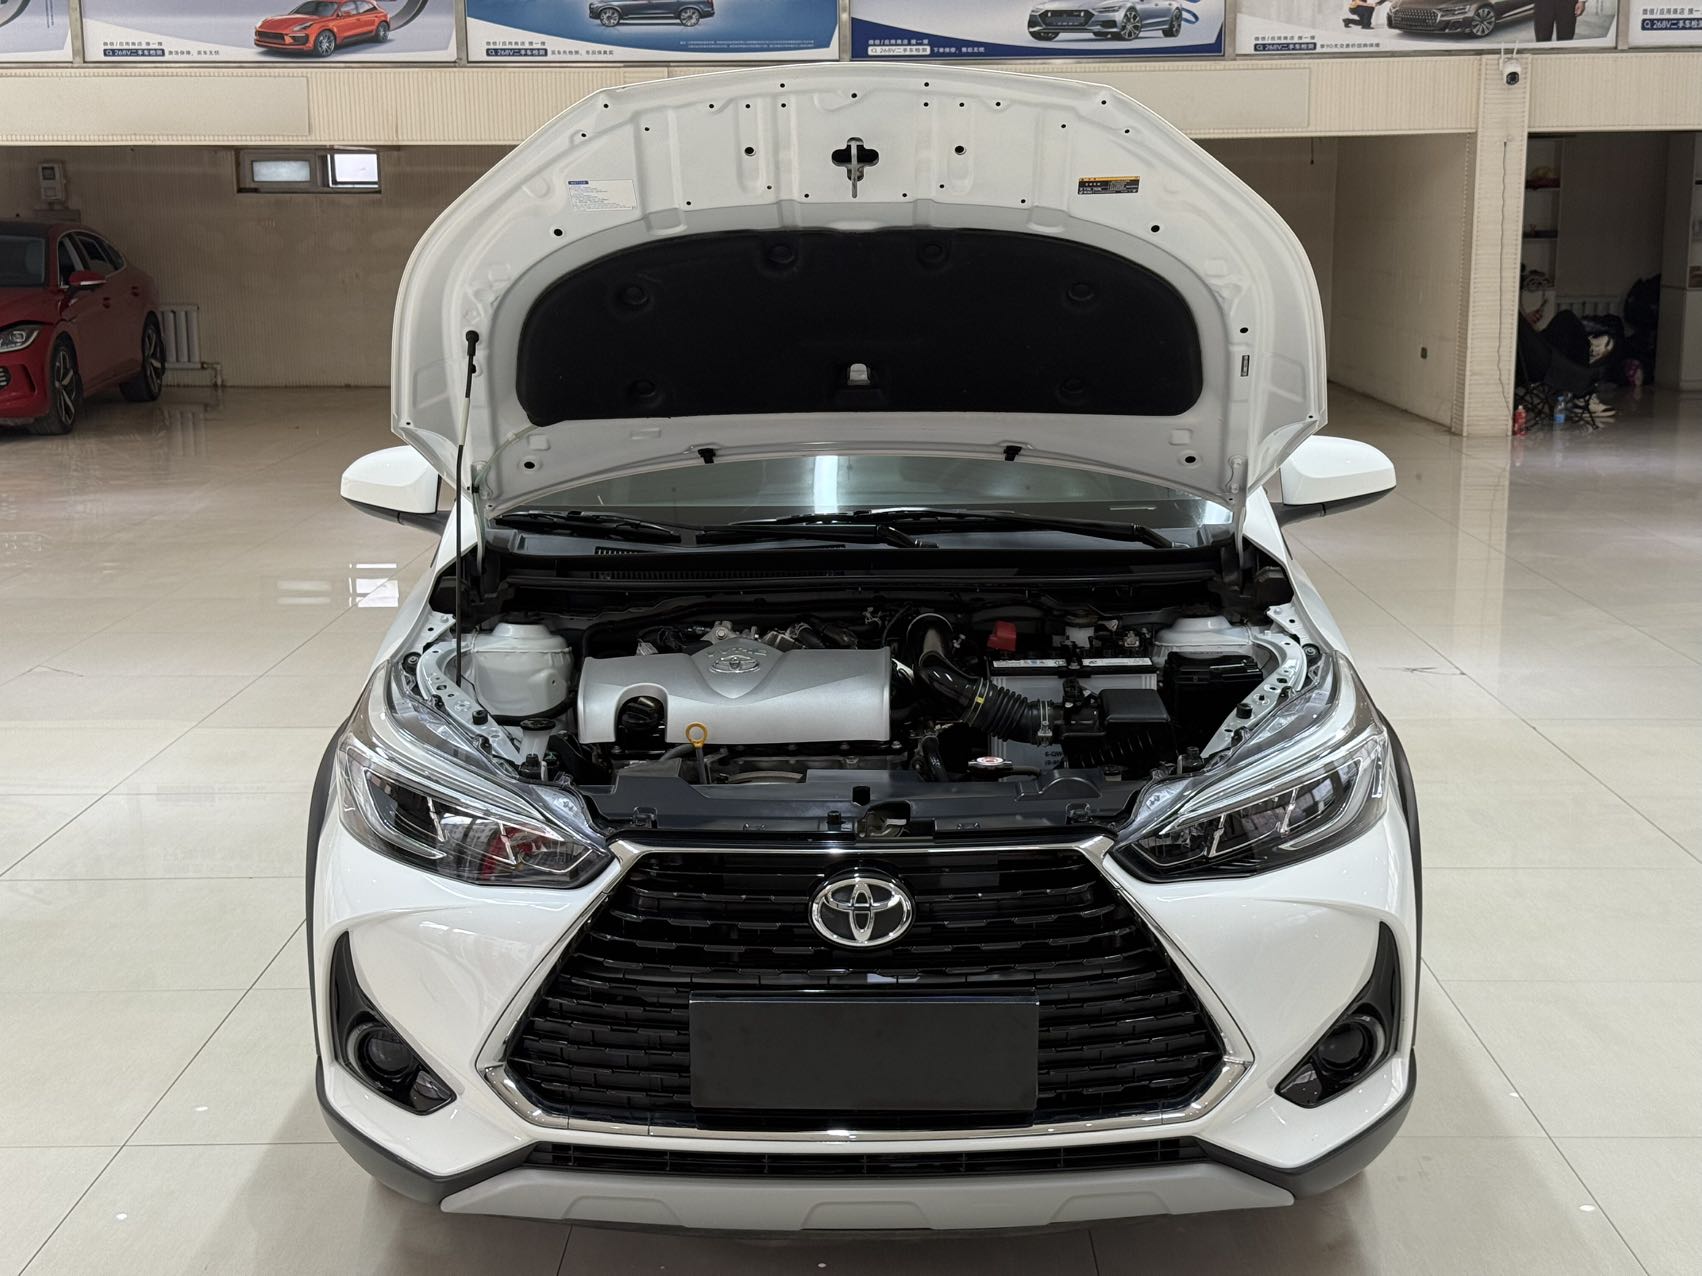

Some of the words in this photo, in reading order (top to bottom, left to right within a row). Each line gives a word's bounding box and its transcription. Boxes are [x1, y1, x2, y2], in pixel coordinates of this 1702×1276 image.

[1264, 43, 1315, 51] 268V二手车检测
